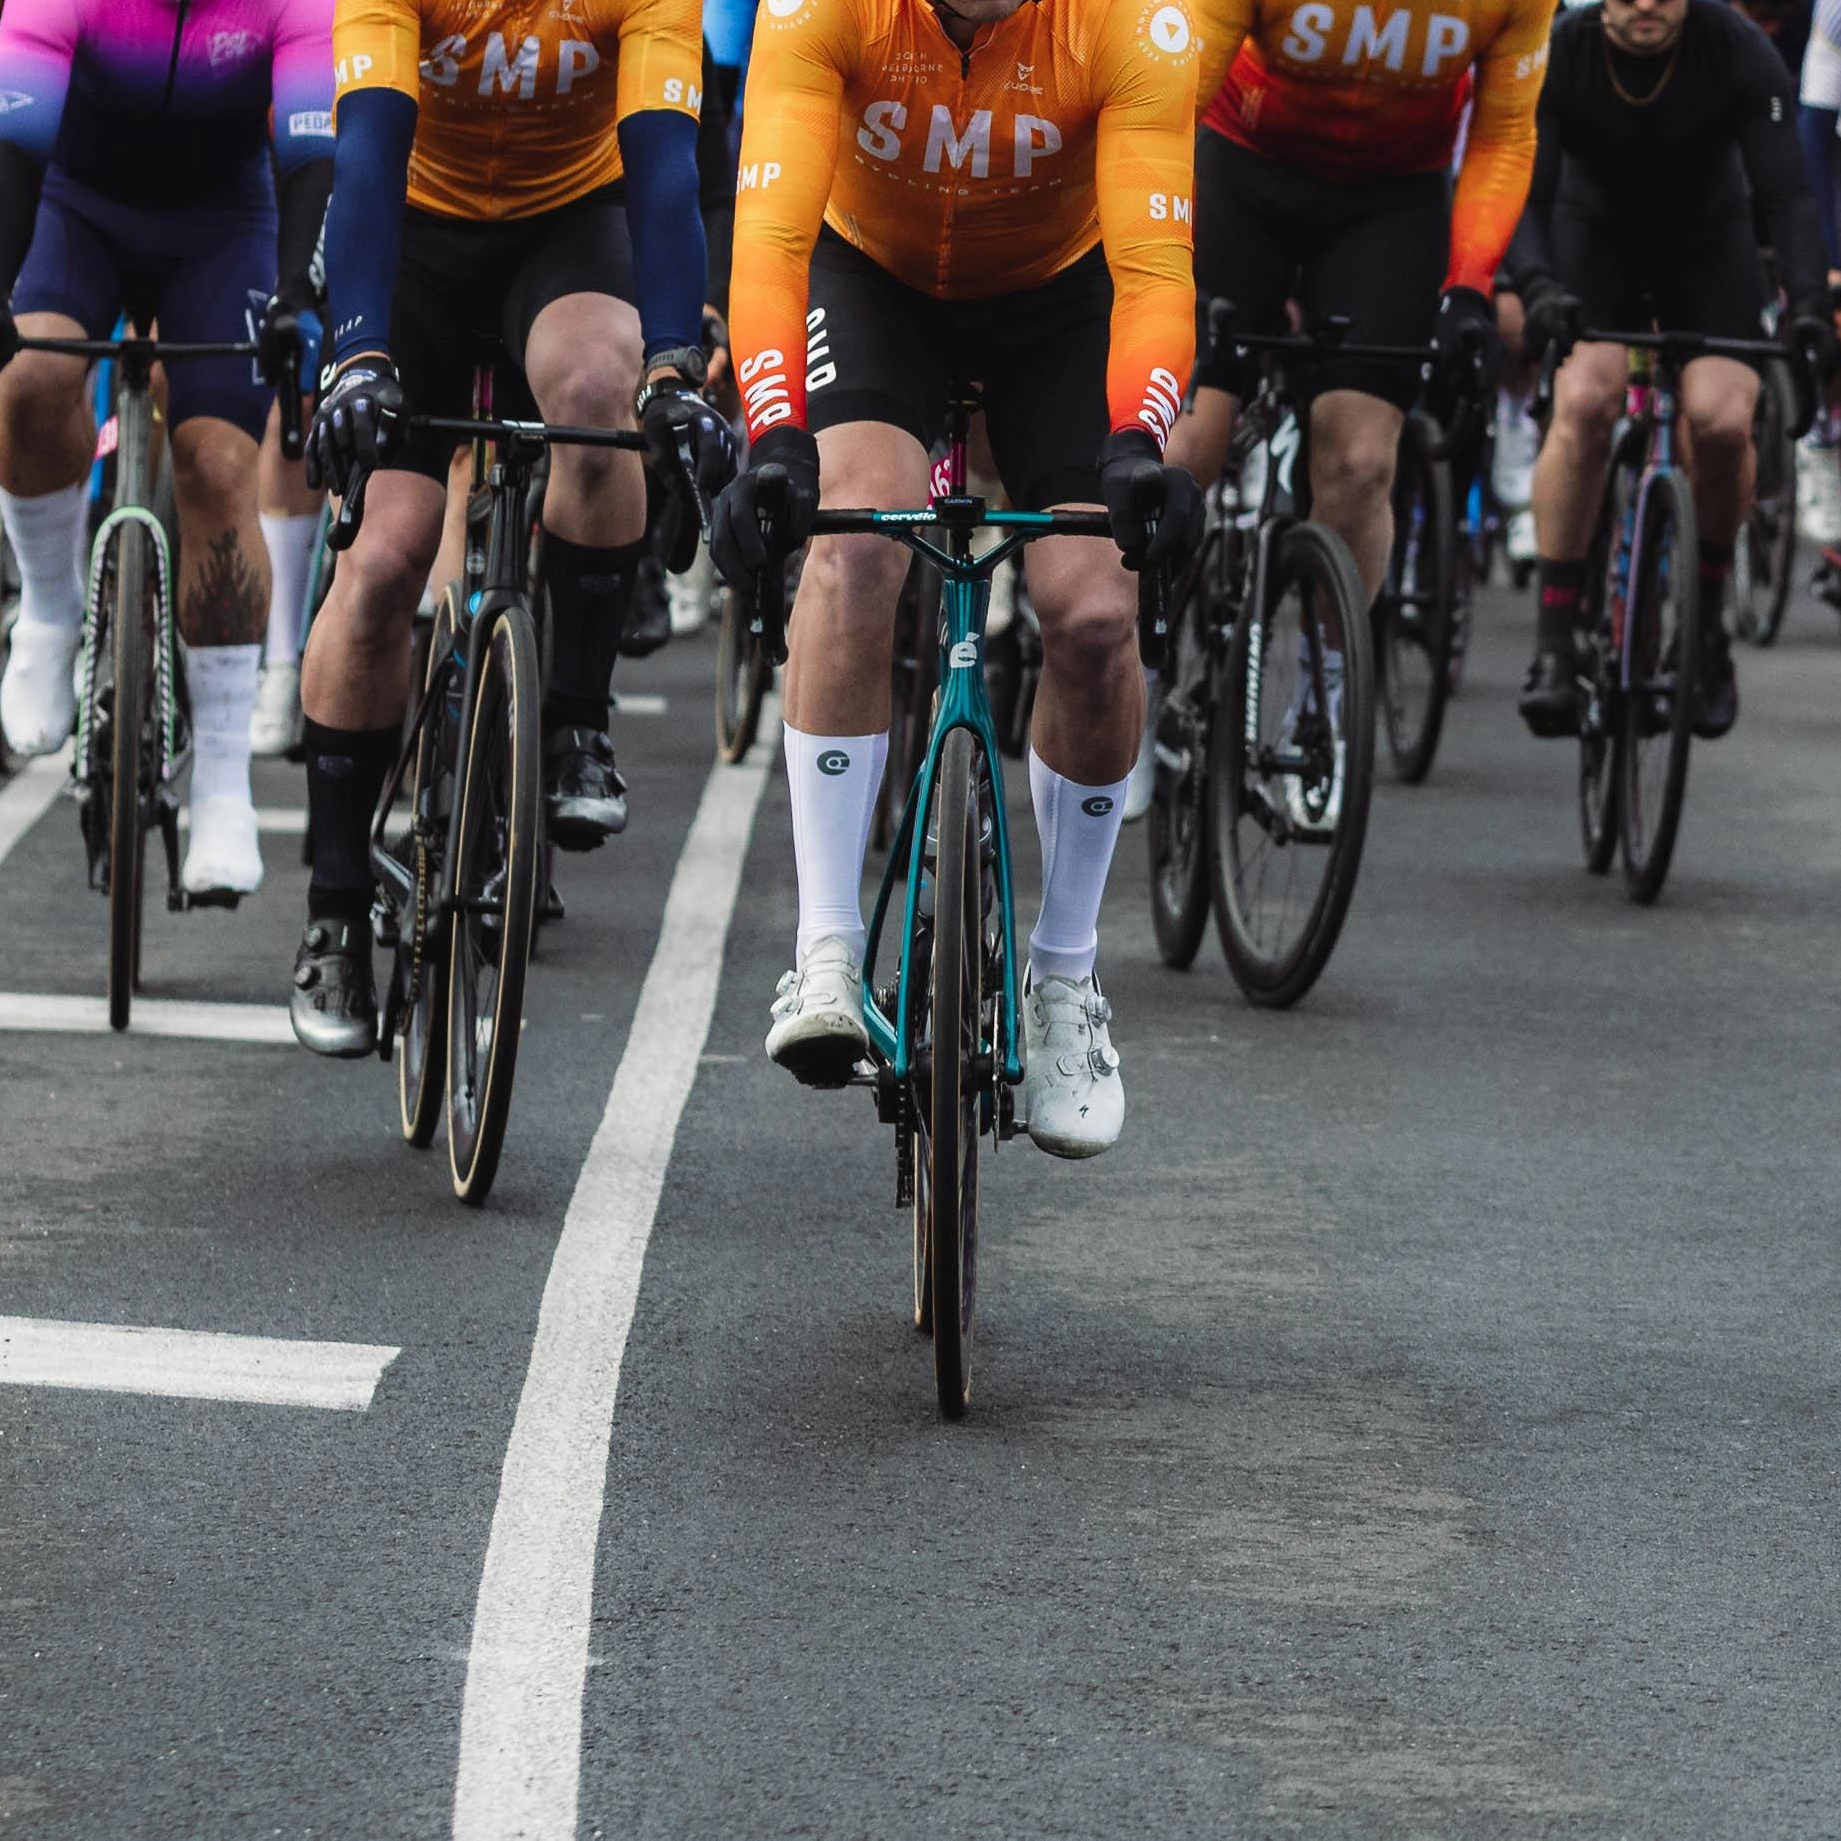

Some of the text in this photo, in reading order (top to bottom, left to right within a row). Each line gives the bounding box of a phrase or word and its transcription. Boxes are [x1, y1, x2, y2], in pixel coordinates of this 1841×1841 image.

[420, 32, 599, 99] SMP
[1281, 3, 1469, 77] SMP
[335, 54, 372, 85] MP
[663, 78, 702, 116] SM
[857, 100, 1062, 179] SMP
[736, 162, 782, 196] MP
[1149, 193, 1193, 227] SM
[740, 347, 794, 432] SMP
[1138, 366, 1183, 453] SMP
[881, 512, 937, 522] cervélo
